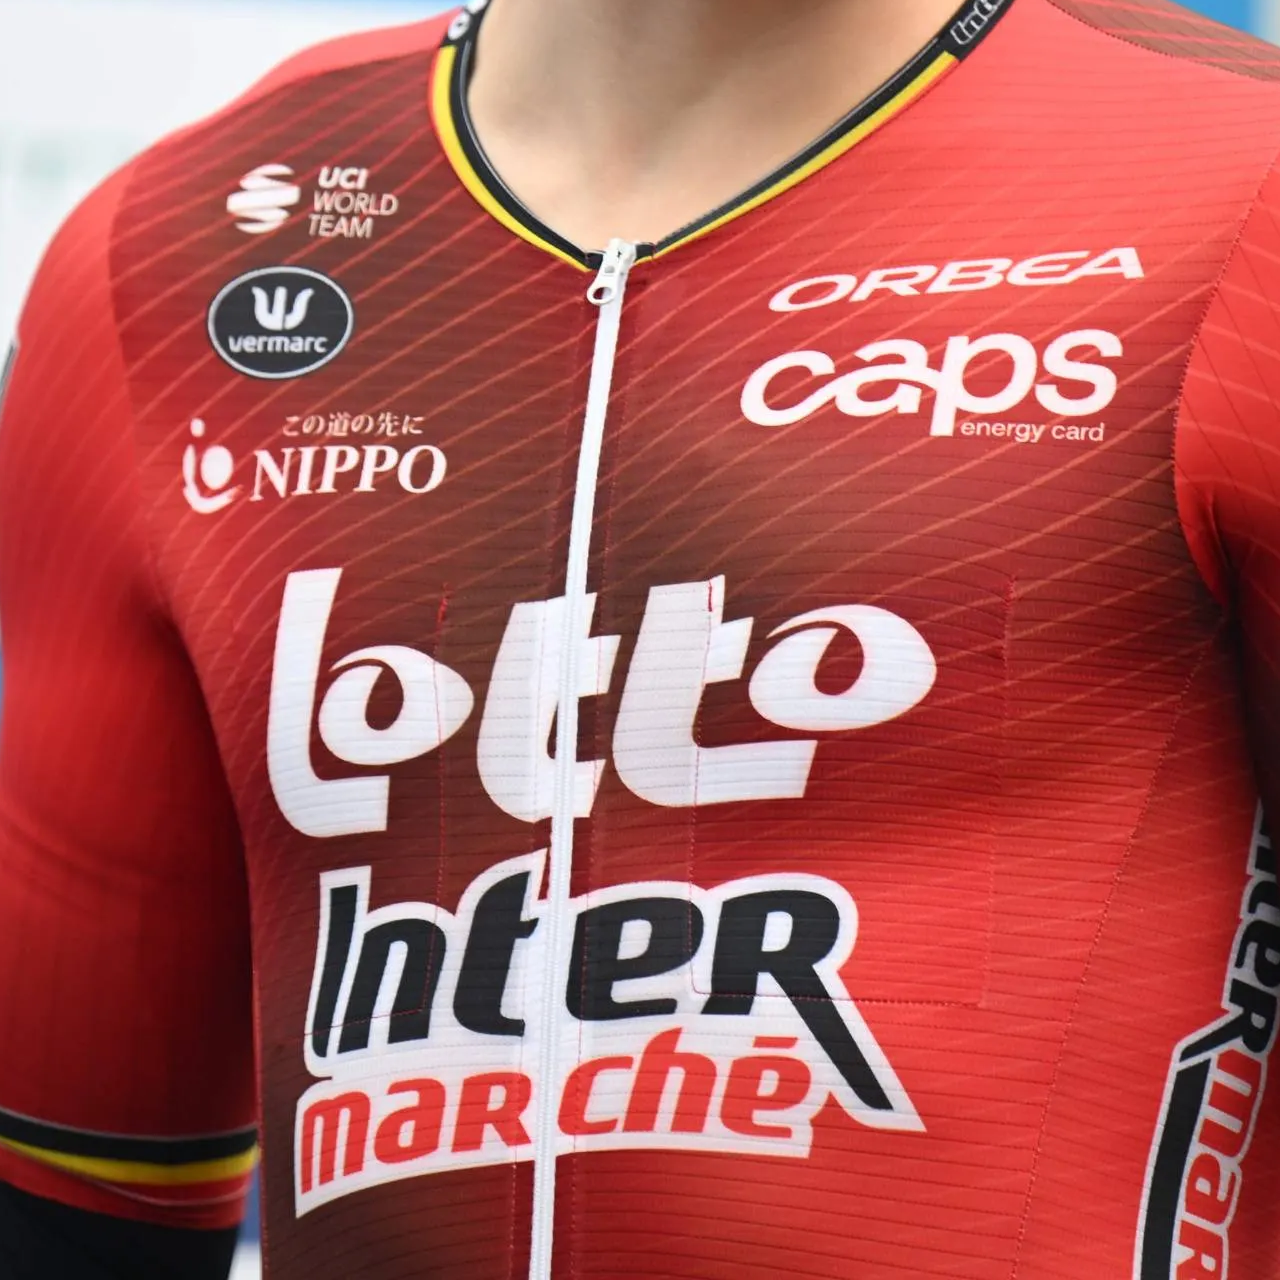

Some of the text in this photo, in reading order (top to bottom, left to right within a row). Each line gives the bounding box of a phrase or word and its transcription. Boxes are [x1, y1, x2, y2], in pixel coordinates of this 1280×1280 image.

[318, 166, 369, 189] UCI
[313, 191, 400, 216] WORLD
[308, 214, 374, 239] TEAM
[767, 246, 1145, 313] ORBEA
[228, 334, 328, 354] vermarc
[739, 328, 1124, 437] caps
[282, 412, 425, 437] この道の先に
[960, 421, 1105, 444] energy card
[249, 443, 448, 502] NIPPO
